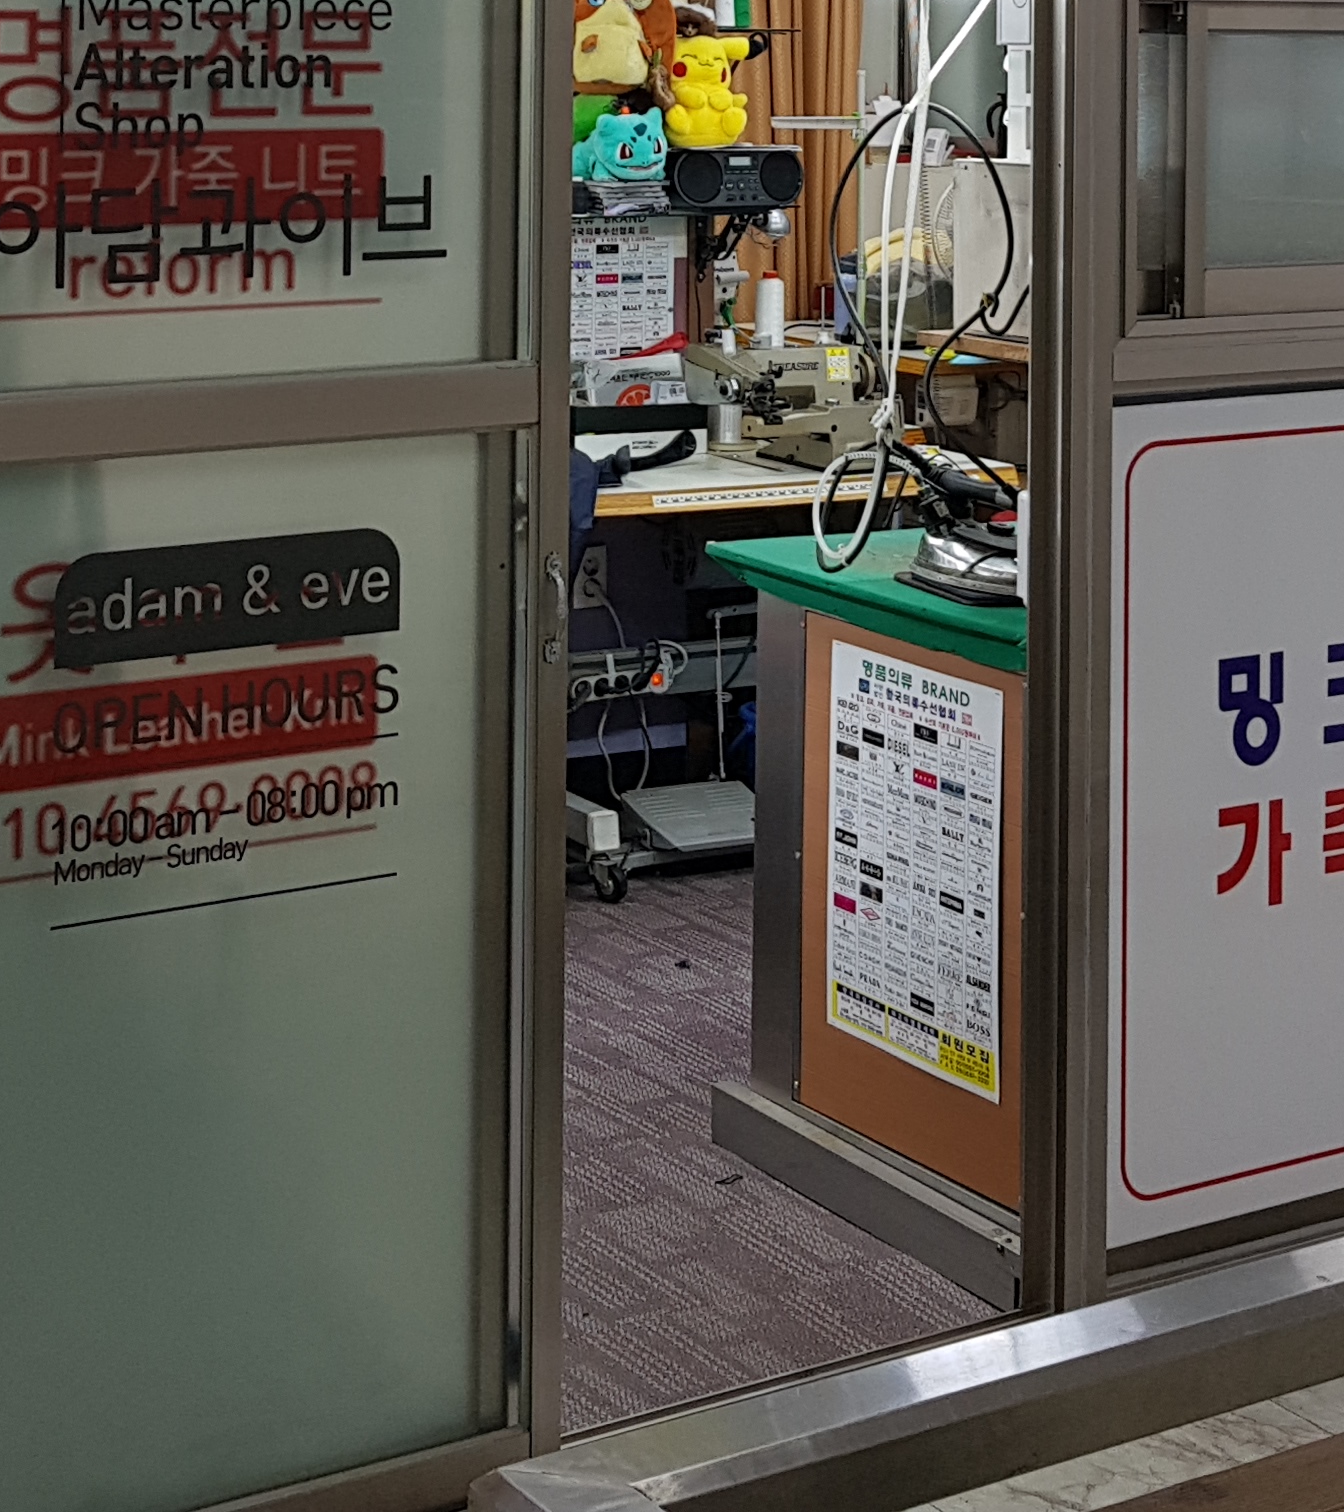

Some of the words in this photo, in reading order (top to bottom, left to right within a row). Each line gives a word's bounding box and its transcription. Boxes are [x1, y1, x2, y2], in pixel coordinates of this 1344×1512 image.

[73, 41, 333, 91] Alteration
[74, 101, 205, 153] Shop
[135, 143, 240, 210] 가죽
[262, 143, 363, 200] 니트
[66, 576, 222, 636] adam
[243, 563, 281, 617] &
[299, 564, 392, 611] eve
[54, 686, 203, 755] OPEN
[222, 663, 399, 736] HOURS
[922, 679, 971, 707] BRAND
